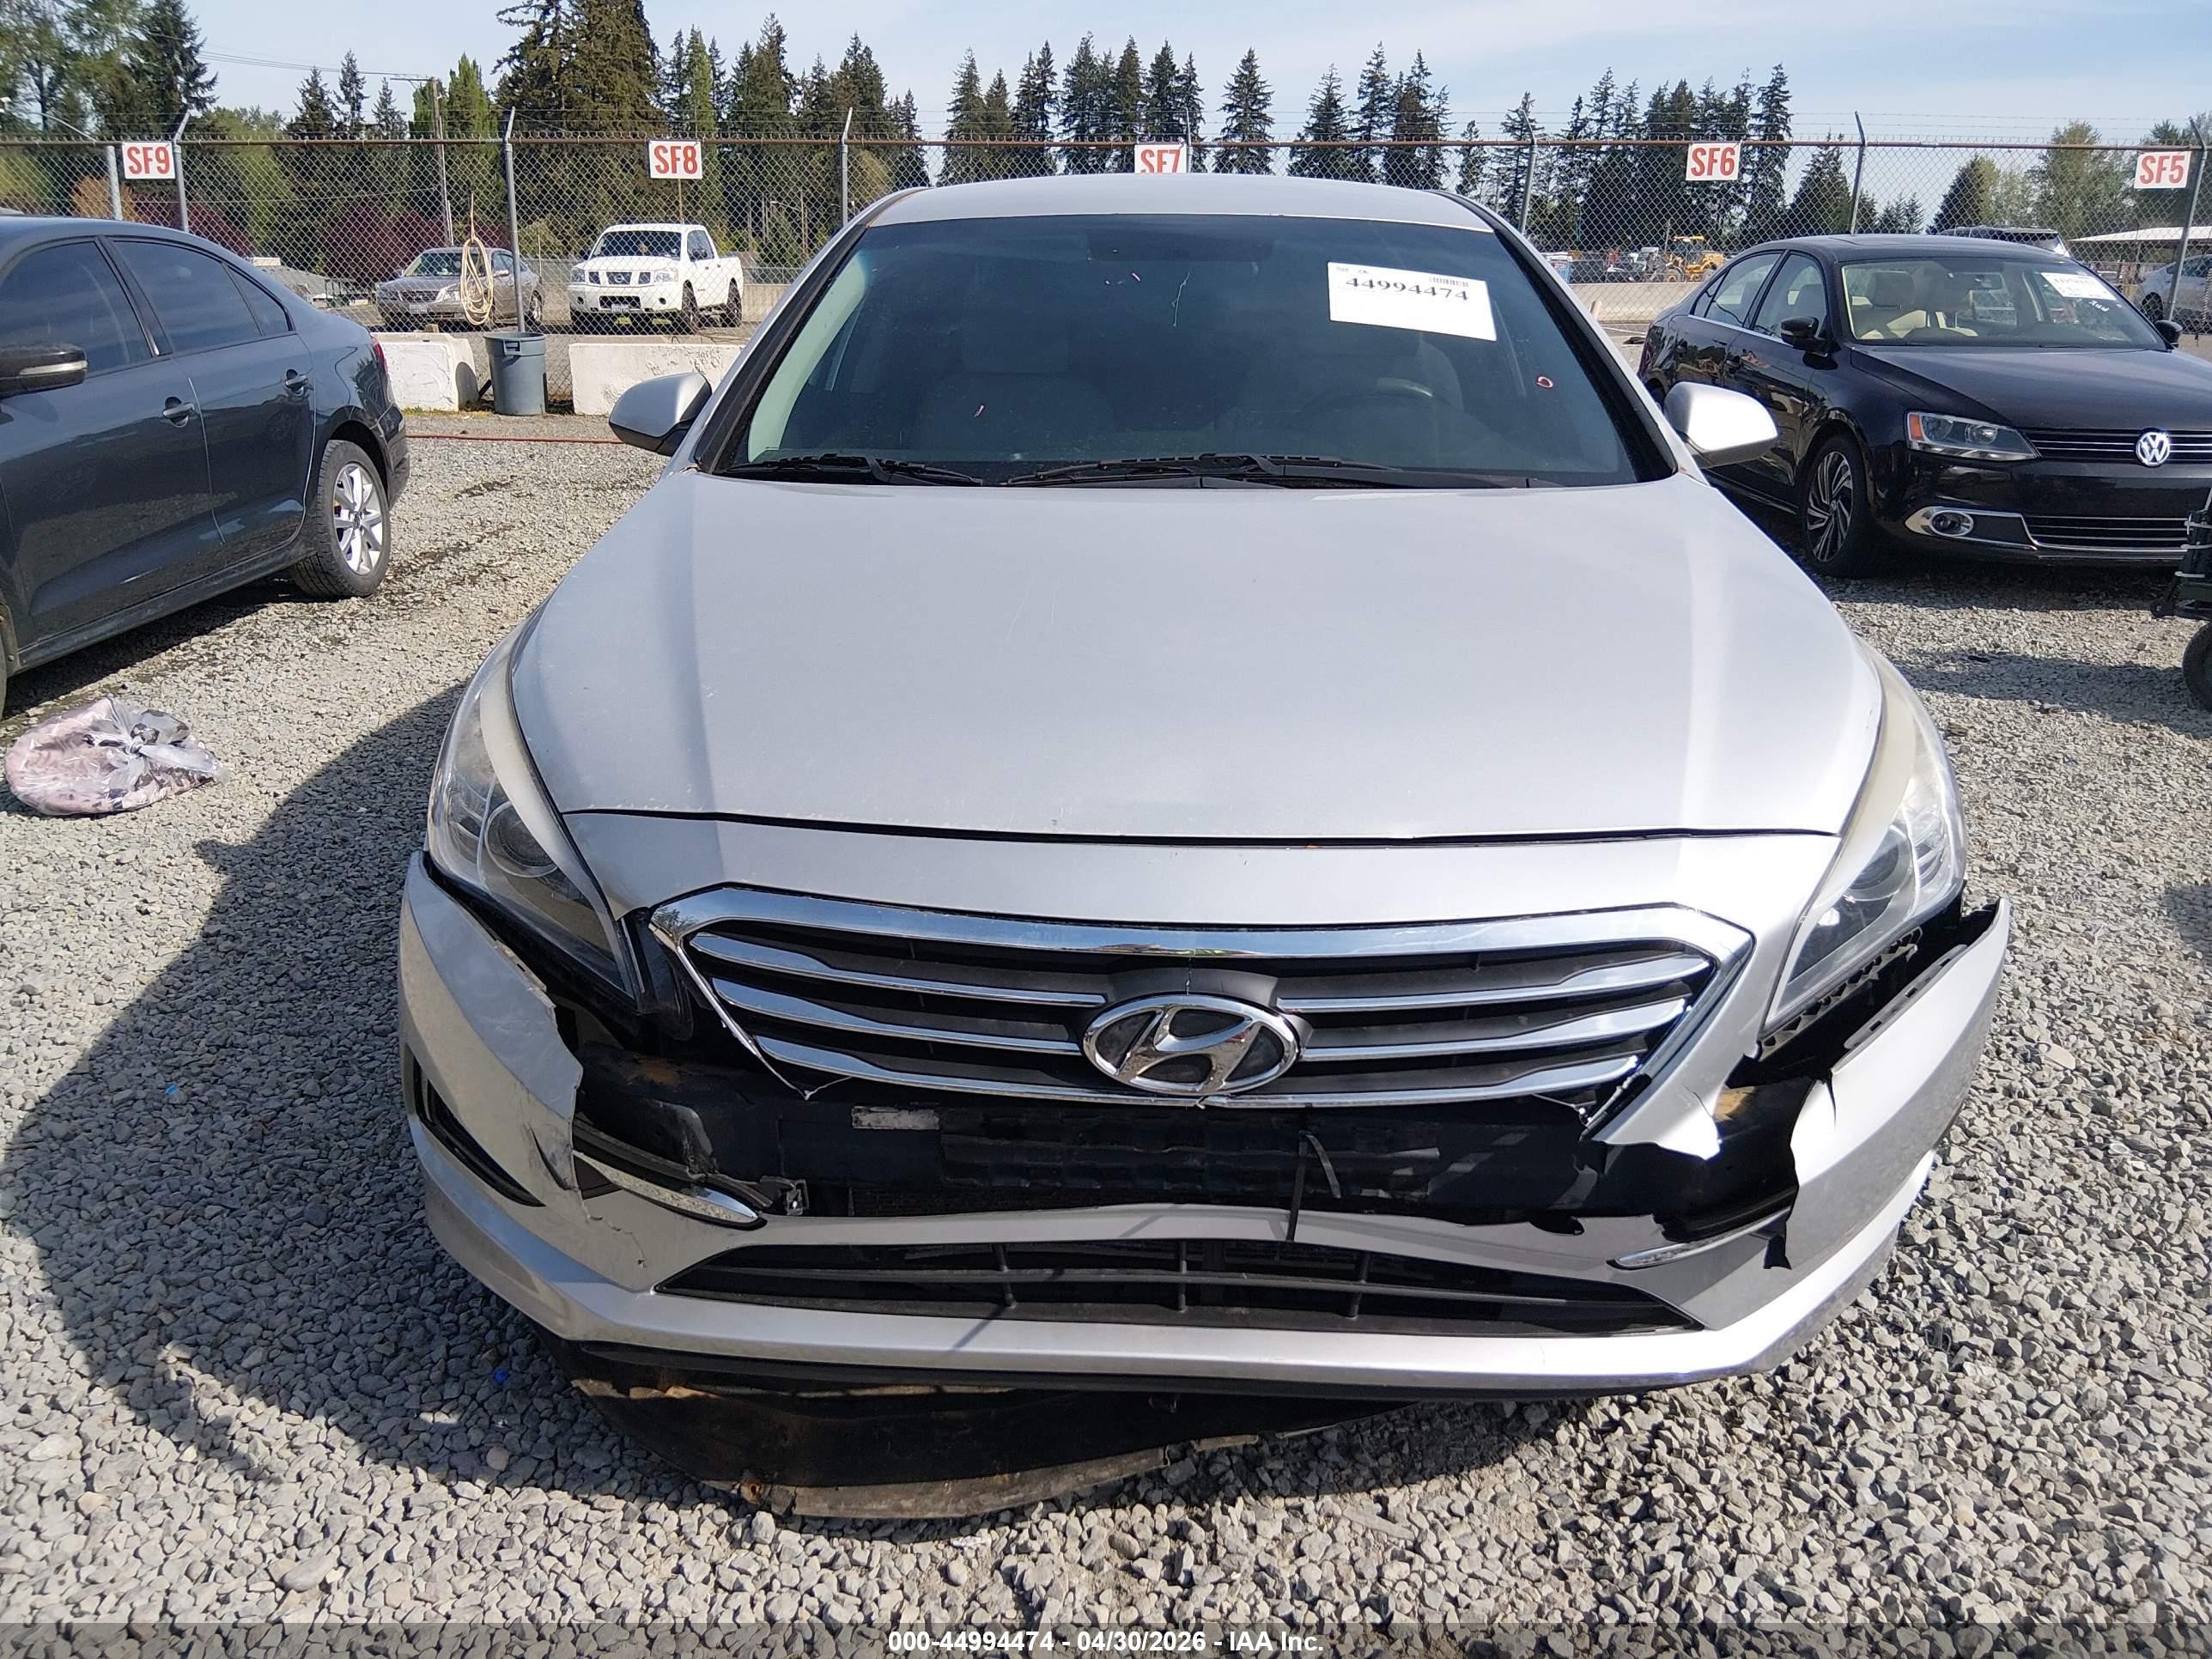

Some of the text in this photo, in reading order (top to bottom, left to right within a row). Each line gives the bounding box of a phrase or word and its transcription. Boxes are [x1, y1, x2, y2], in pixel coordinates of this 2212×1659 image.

[126, 146, 170, 174] SF9
[654, 145, 697, 174] SF8
[1140, 149, 1182, 173] SF7
[1691, 147, 1735, 176] SF6
[2140, 155, 2184, 184] SF5
[1346, 276, 1469, 301] 44994474
